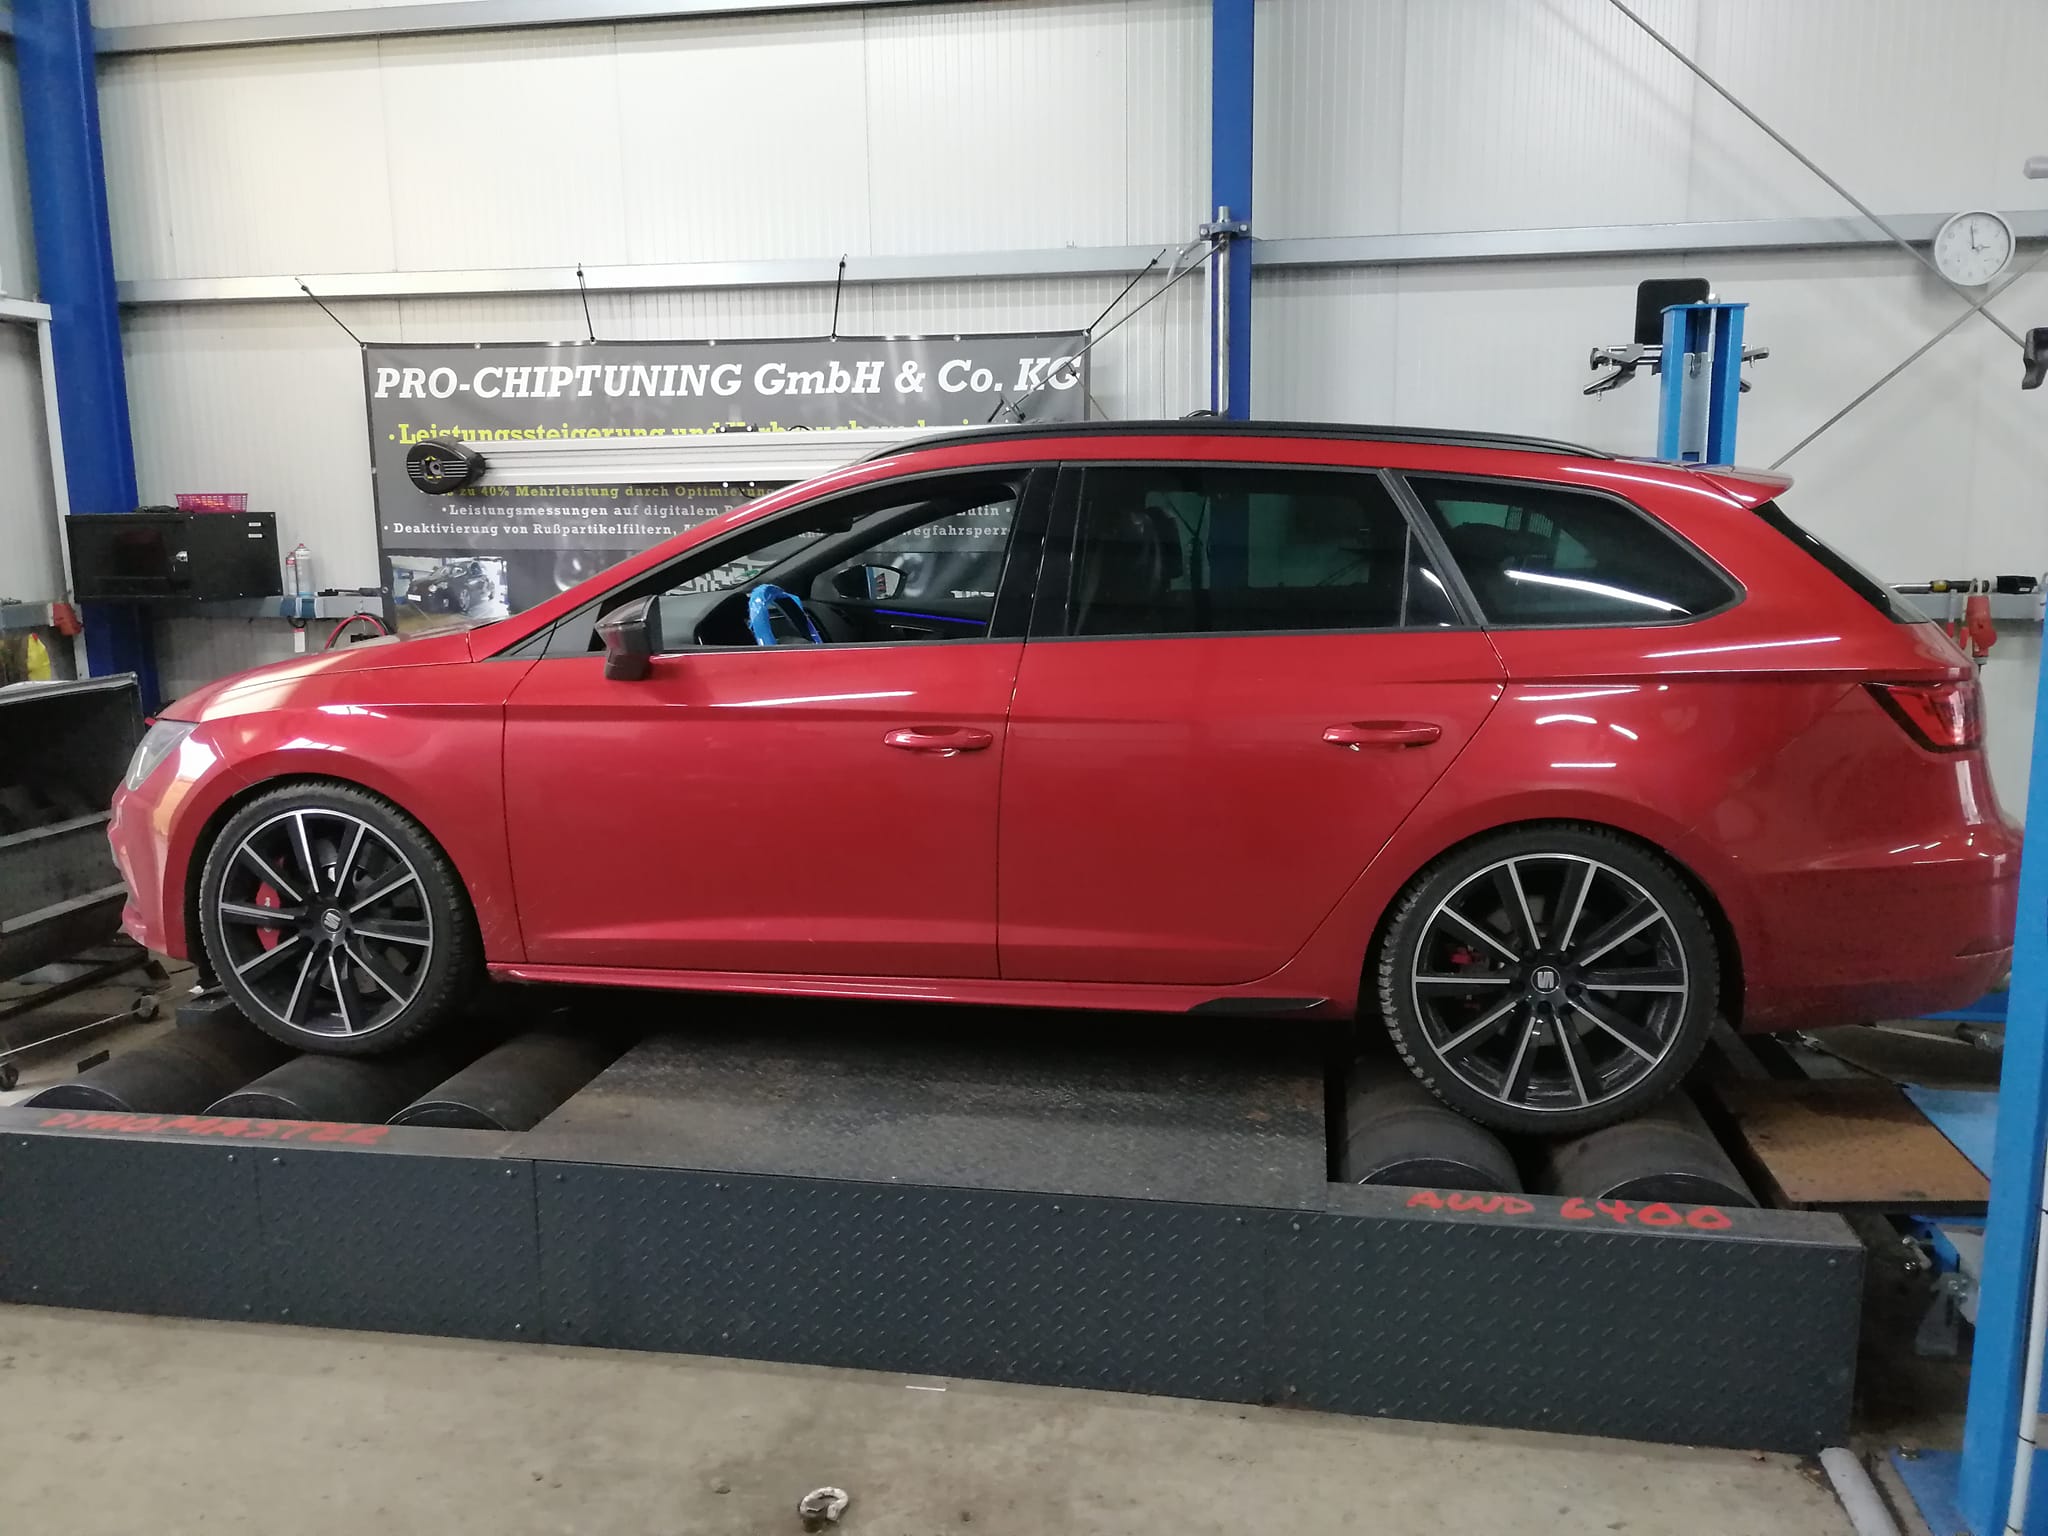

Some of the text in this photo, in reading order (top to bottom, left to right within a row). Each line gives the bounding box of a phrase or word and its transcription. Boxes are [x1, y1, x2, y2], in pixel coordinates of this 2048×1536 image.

[374, 357, 1082, 399] PRO-CHIPTUNING GmbH & Co. KG
[481, 486, 510, 497] 40%
[515, 485, 619, 499] Mehrleistung
[625, 485, 669, 497] durch
[449, 504, 608, 518] Leistungsmessungen
[613, 504, 639, 516] auf
[643, 504, 719, 518] digitalem
[956, 504, 1000, 516] utin
[393, 522, 498, 536] Deaktivierung
[503, 524, 530, 534] von
[532, 522, 677, 536] Rußpartikelfiltern,
[903, 525, 1010, 538] egfahrsperr
[1406, 1191, 1733, 1230] AWD 6400
